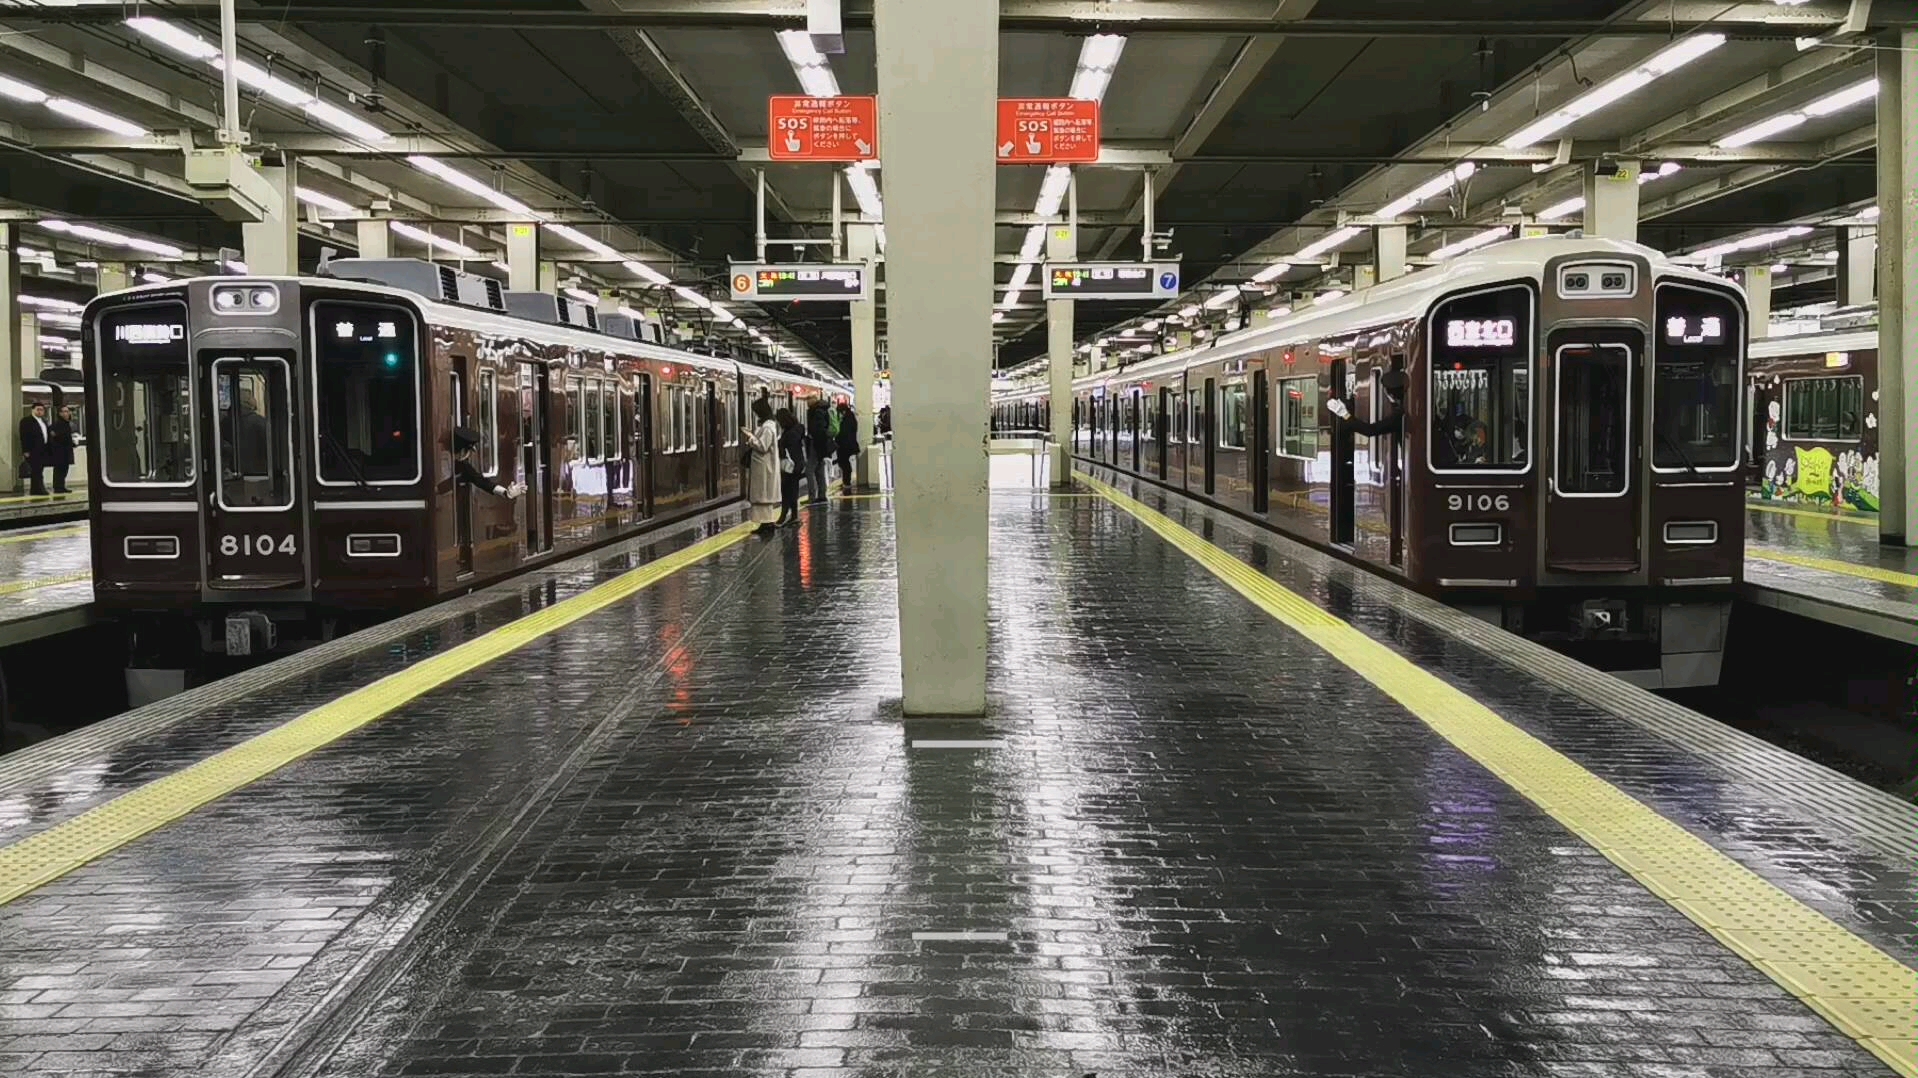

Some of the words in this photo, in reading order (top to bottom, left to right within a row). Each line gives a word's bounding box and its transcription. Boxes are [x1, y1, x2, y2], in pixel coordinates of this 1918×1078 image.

[778, 118, 807, 129] SOS
[1019, 120, 1048, 132] SOS
[736, 276, 747, 290] 6
[1163, 274, 1174, 288] 7
[1448, 494, 1510, 511] 9106
[220, 534, 297, 556] 8104
